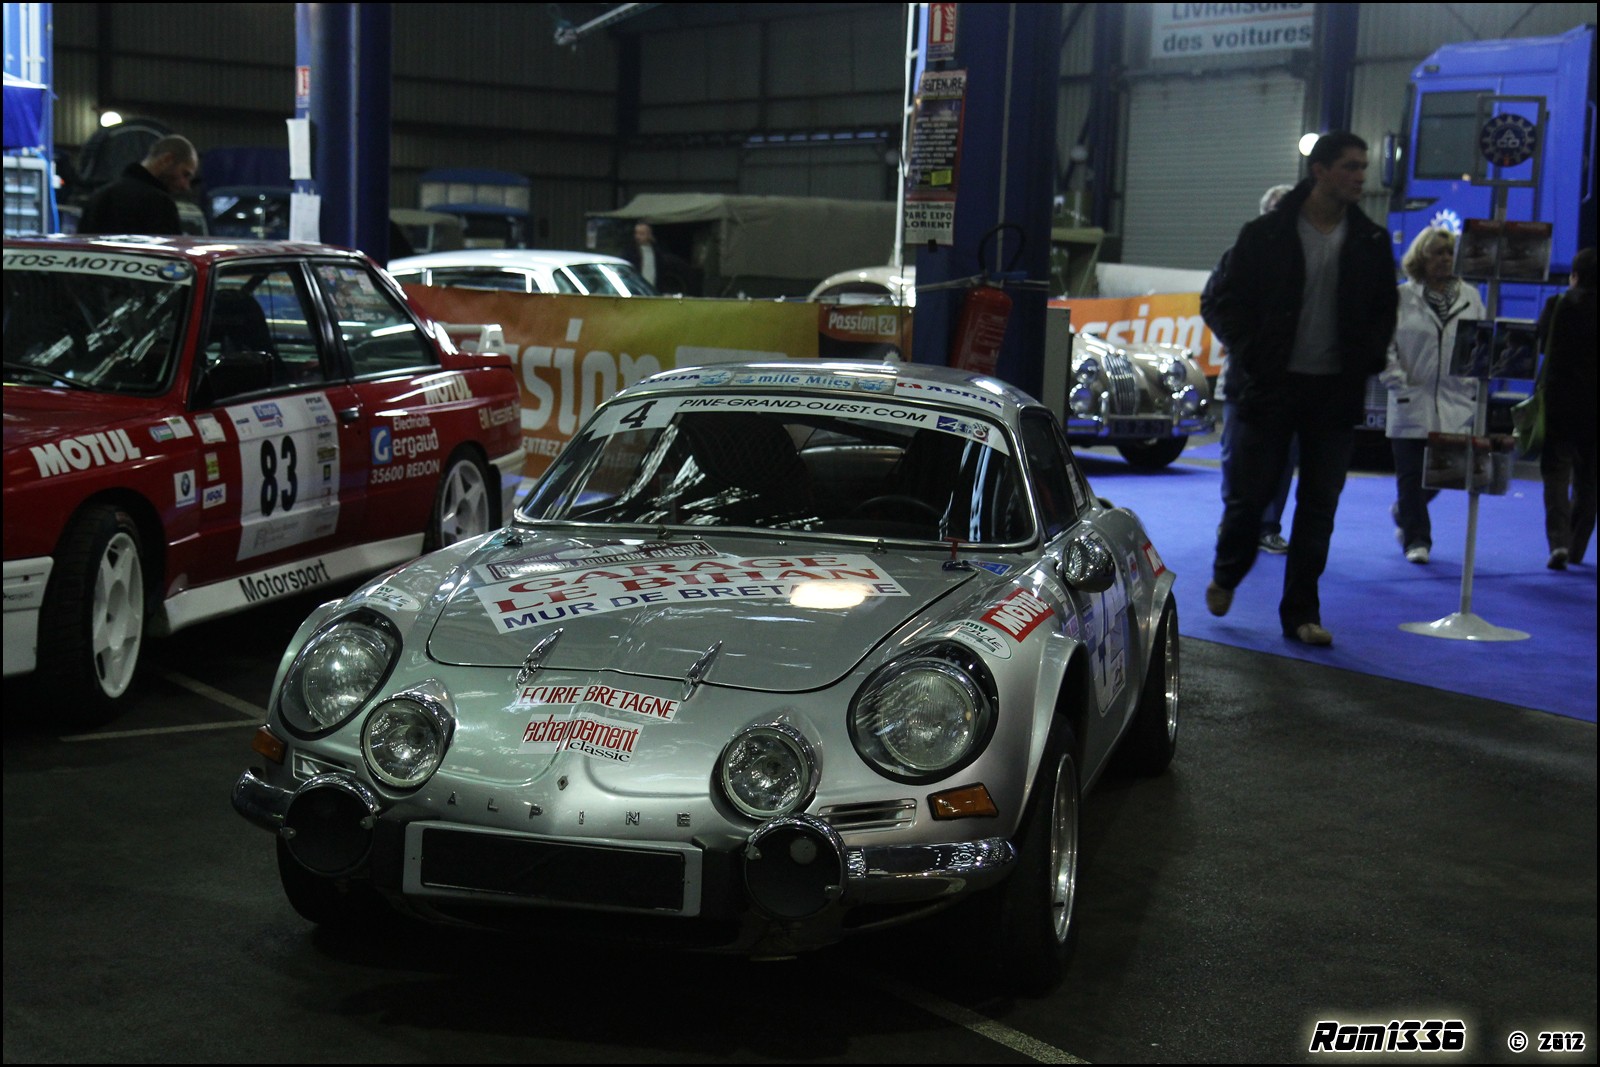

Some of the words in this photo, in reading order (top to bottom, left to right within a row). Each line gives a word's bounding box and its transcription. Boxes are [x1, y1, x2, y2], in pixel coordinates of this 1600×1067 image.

[1163, 33, 1202, 51] des
[1212, 25, 1311, 48] voitures
[904, 221, 951, 229] LORIENT
[930, 212, 952, 220] EXPO
[3, 253, 158, 277] TOS-MOTOS
[828, 311, 877, 331] Passion
[880, 317, 894, 333] 24
[422, 374, 473, 405] MOTUL
[503, 318, 664, 436] sion
[758, 374, 800, 384] mille
[926, 384, 1003, 409] ADRIA
[620, 400, 657, 429] 4
[28, 428, 142, 478] MOTUL
[374, 429, 440, 462] Gergaud
[260, 435, 298, 516] 83
[370, 466, 404, 485] 35600
[405, 458, 441, 479] REDON
[577, 551, 649, 567] AQUITAINE
[650, 542, 708, 559] CLASSIC
[239, 559, 331, 602] Motorsport
[508, 557, 847, 592] GARAGE
[493, 585, 597, 614] LE
[619, 568, 880, 592] BIHAN
[503, 602, 600, 629] MUR
[610, 591, 668, 608] DE
[678, 584, 901, 599] BRETE
[991, 591, 1049, 635] MOTUL
[519, 687, 583, 704] ECURIE
[583, 685, 678, 720] BRETAGNE
[524, 714, 639, 752] echappement
[569, 741, 631, 763] classic
[447, 791, 691, 827] ALPINE
